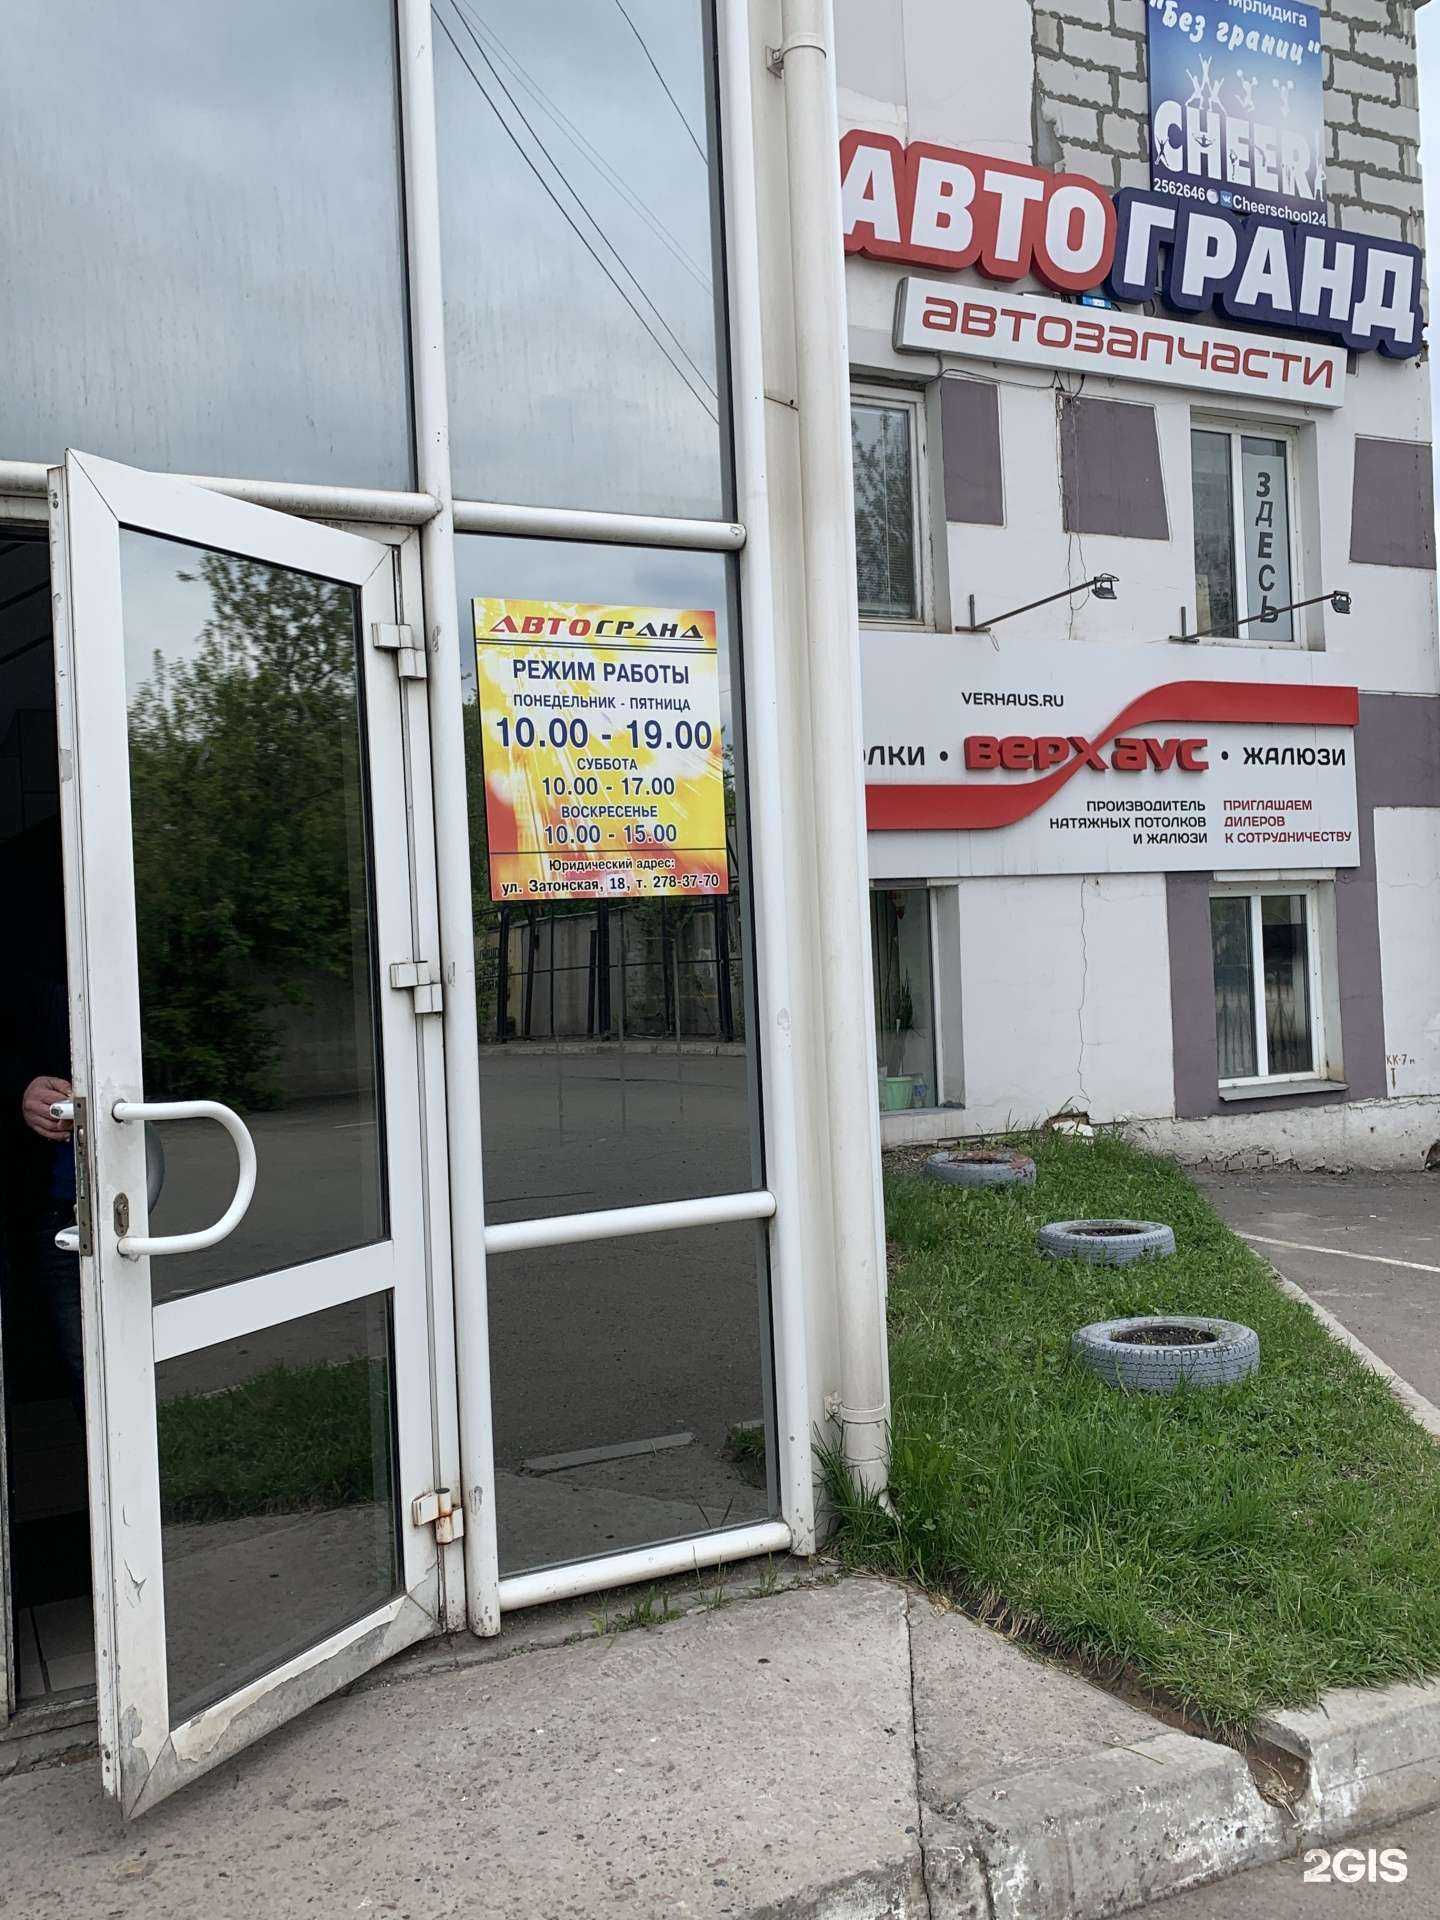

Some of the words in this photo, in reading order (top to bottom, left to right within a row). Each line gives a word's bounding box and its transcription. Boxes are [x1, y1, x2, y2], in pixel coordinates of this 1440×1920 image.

[1153, 177, 1206, 202] 2562646
[1232, 194, 1328, 227] Cheerschool24
[1254, 471, 1279, 624] ЗДЕСЬ
[512, 659, 596, 682] РЕЖИМ
[603, 662, 690, 685] РАБОТЫ
[513, 693, 616, 710] ПОНЕДЕЛЬНИК
[629, 697, 691, 713] ПЯТНИЦА
[960, 691, 1065, 708] VERHAUS.RU
[496, 716, 589, 749] 10.00
[626, 719, 713, 750] 19.00
[576, 757, 638, 771] СУББОТА
[863, 745, 925, 766] ЛКИ
[1242, 746, 1347, 766] ЖАЛЮЗИ
[542, 776, 599, 796] 10.00
[621, 776, 676, 796] 17.00
[561, 805, 658, 819] ВОСКРЕСЕНЬЕ
[1086, 800, 1206, 813] ПРОИЗВОДИТЕЛЬ
[1223, 799, 1313, 812] ПРИГЛАШАЕМ
[1049, 816, 1131, 830] НАТЯЖНЫХ
[1135, 815, 1207, 829] ПОТОЛКОВ
[1224, 815, 1286, 829] ДИЛЕРОВ
[544, 825, 601, 845] 10.00
[623, 824, 678, 844] 15.00
[1133, 832, 1143, 845] И
[1146, 831, 1208, 845] ЖАЛЮЗИ
[1224, 832, 1234, 844] К
[1236, 830, 1352, 844] СОТРУДНИЧЕСТВУ
[549, 858, 633, 874] Юридический
[636, 858, 676, 871] адрес:
[501, 883, 523, 896] ул.
[528, 879, 604, 894] Затонская,
[609, 877, 631, 891] 18,
[636, 878, 647, 890] т.
[653, 874, 719, 889] 278-37-70
